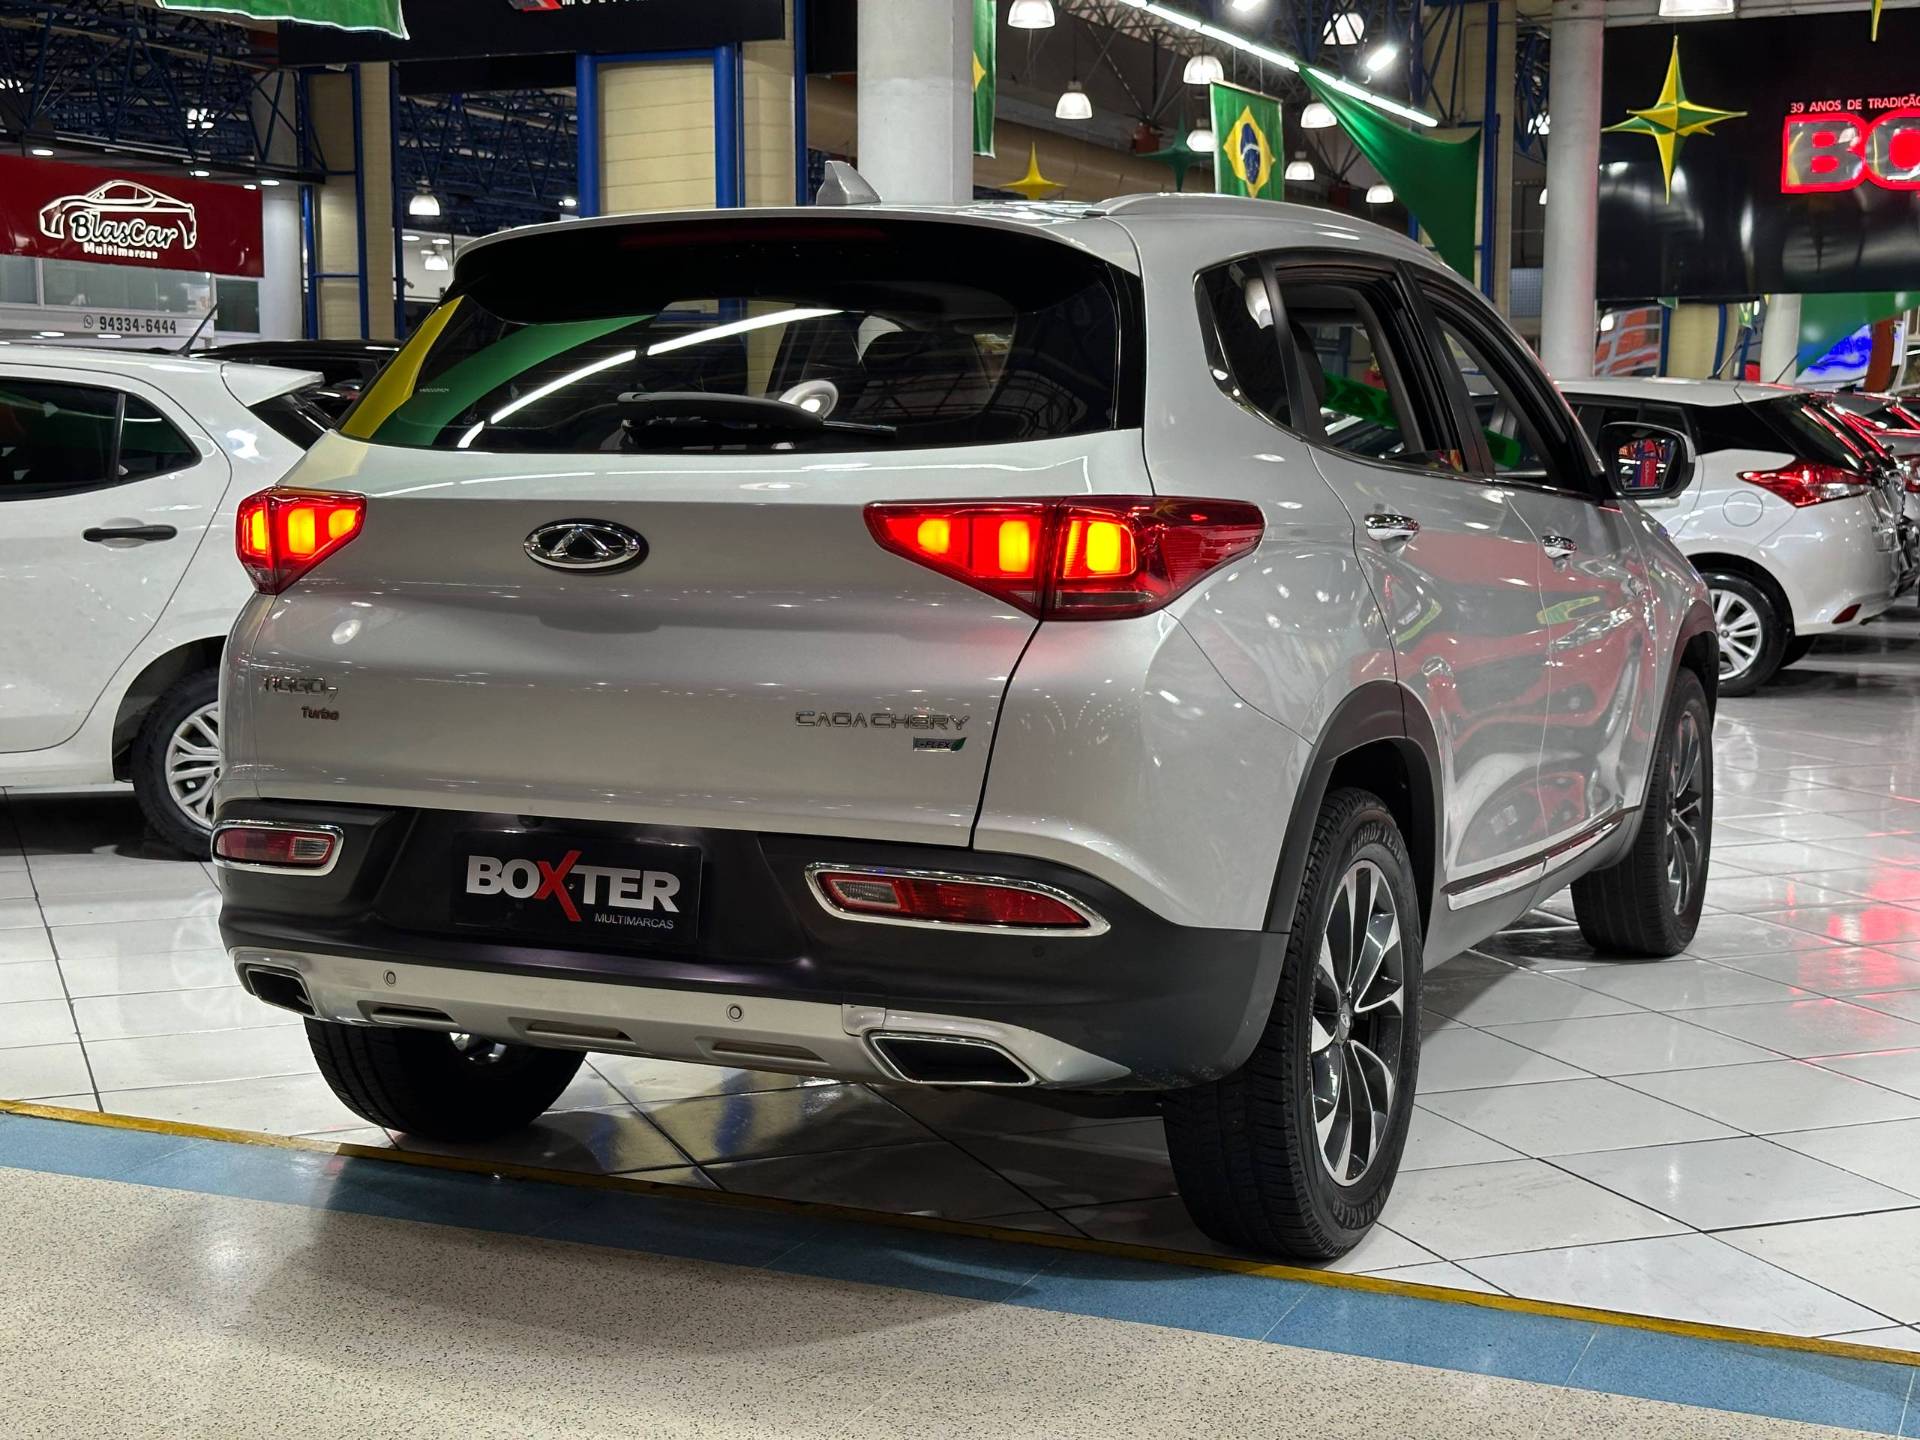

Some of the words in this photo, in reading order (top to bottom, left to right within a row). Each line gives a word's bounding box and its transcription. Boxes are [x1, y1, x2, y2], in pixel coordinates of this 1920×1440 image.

[1790, 102, 1805, 114] 39
[1809, 100, 1841, 112] ANOS
[1847, 98, 1862, 111] DE
[70, 211, 178, 249] BlasCar
[99, 315, 177, 335] 94334-6444
[301, 705, 340, 721] Turbo
[795, 711, 868, 729] CAOA
[870, 712, 970, 731] CHERY
[466, 850, 681, 922] BOXTER
[594, 911, 675, 930] MULTIMARCAS
